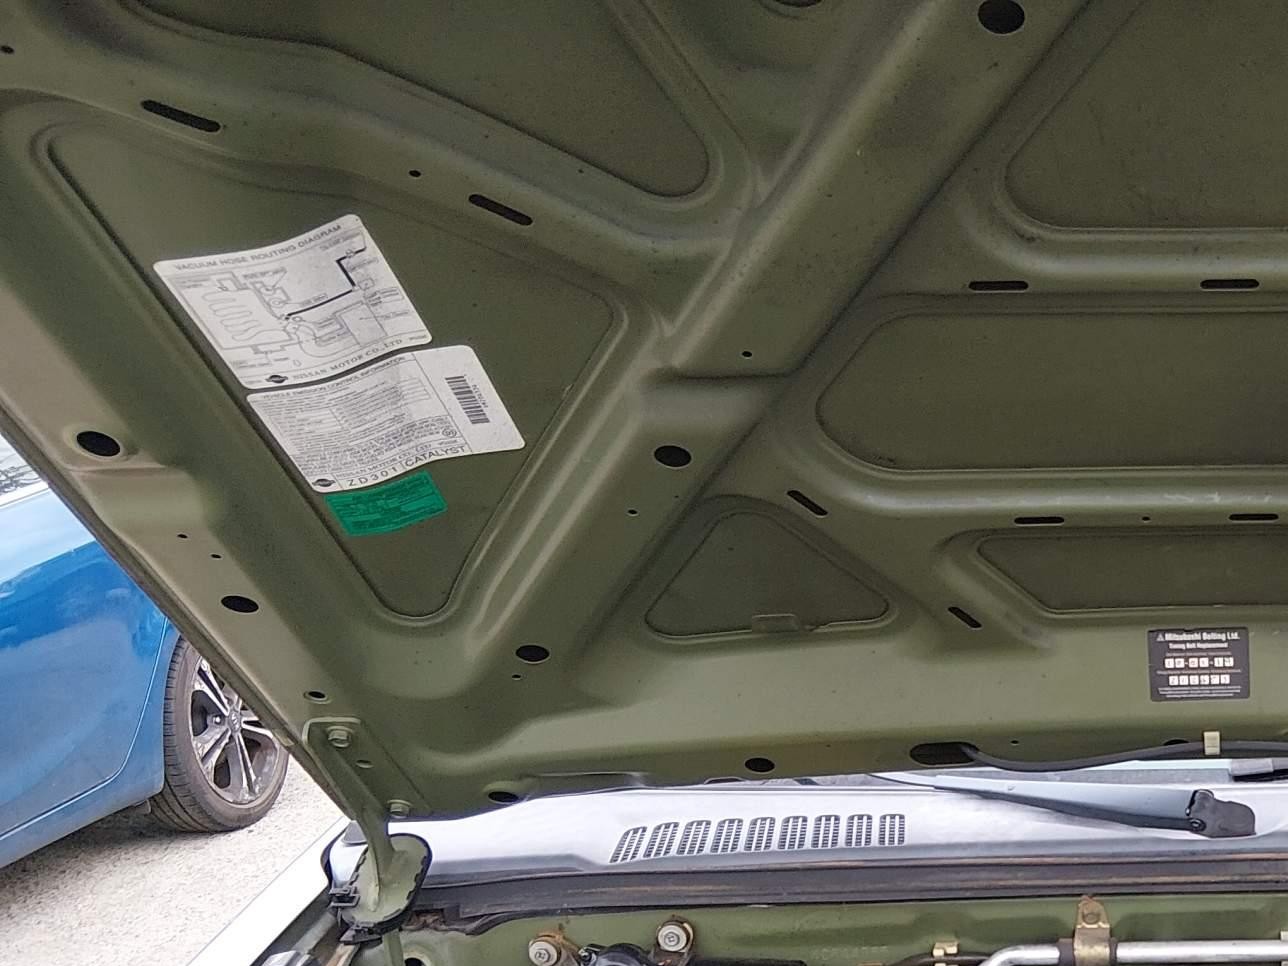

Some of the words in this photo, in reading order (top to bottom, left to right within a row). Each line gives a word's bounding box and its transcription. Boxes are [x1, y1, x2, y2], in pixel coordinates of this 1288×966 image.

[174, 259, 218, 271] VACUUM
[219, 255, 248, 266] HOSE
[250, 244, 297, 261] ROUTING
[297, 224, 342, 249] DIAGRAM
[330, 355, 364, 372] MOTOR
[403, 445, 466, 467] CATALYST
